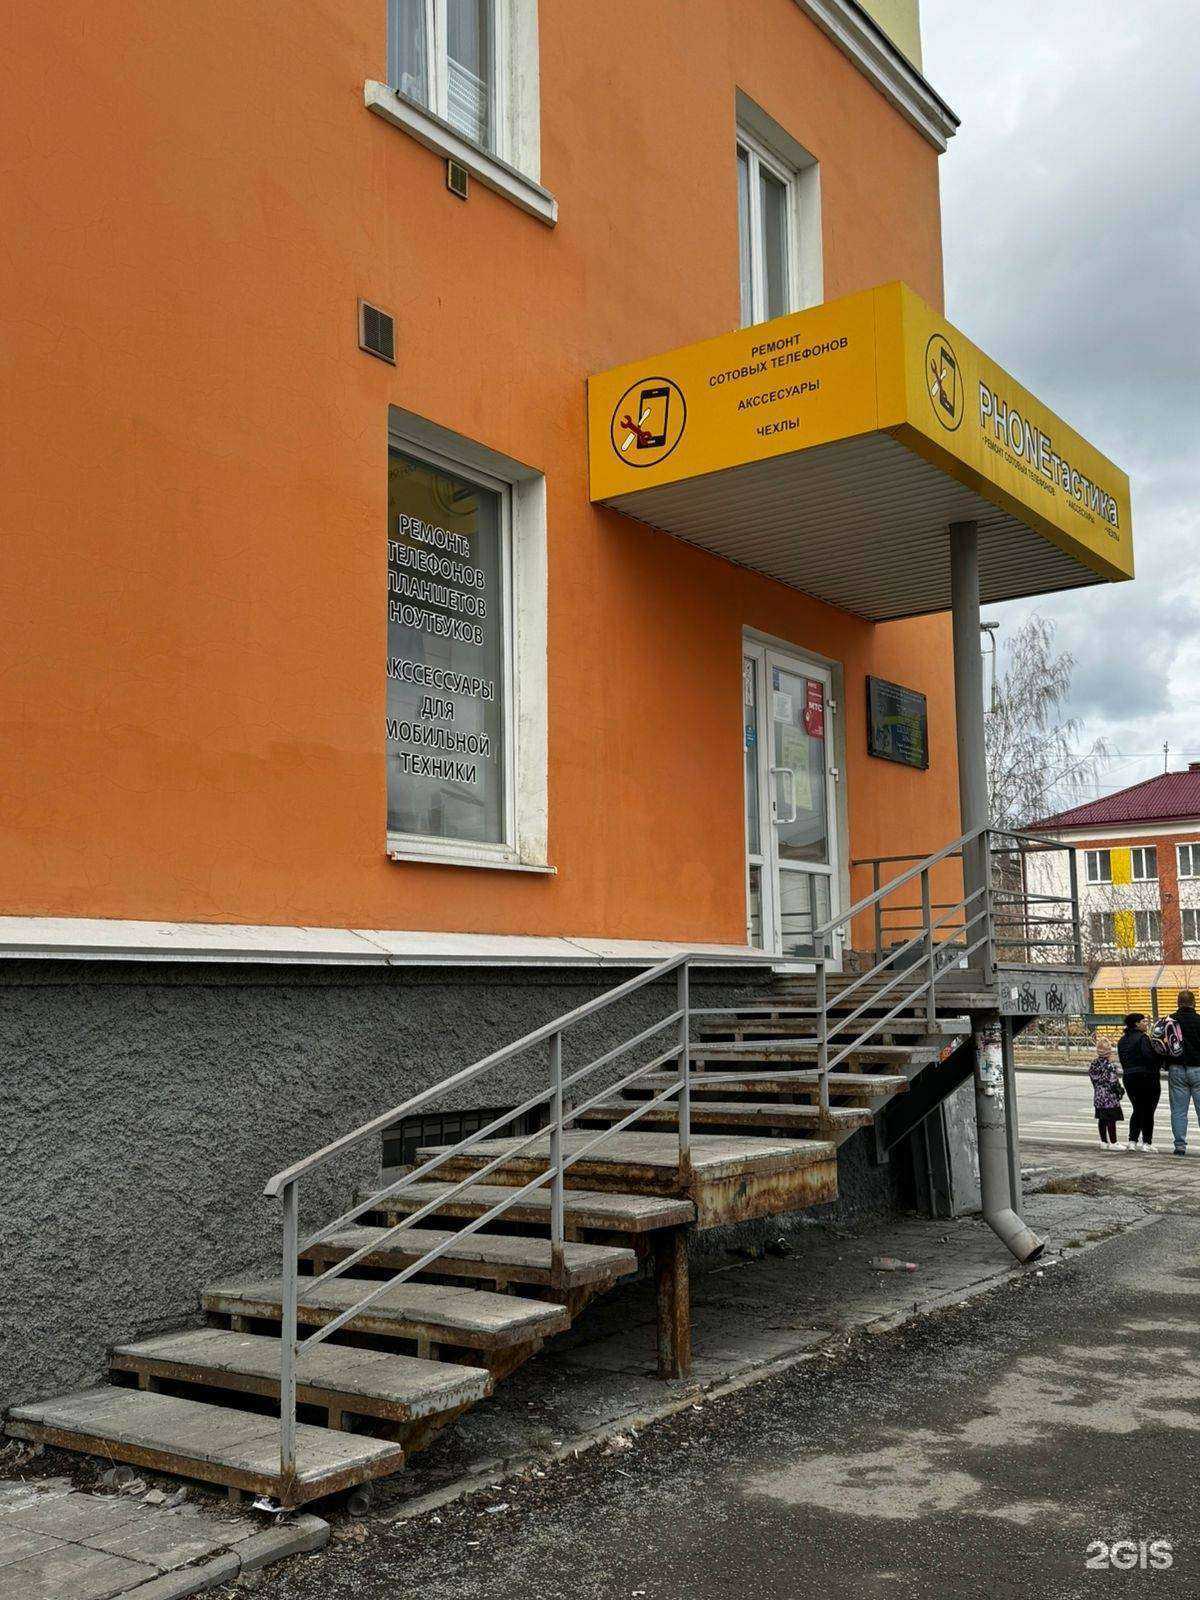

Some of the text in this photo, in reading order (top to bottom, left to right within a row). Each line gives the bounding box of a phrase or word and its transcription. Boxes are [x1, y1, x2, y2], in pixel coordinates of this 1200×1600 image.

[708, 337, 848, 387] СОТОВЫХ ТЕЛЕФОНОВ
[751, 334, 801, 358] РЕМОНТ
[737, 379, 820, 411] АКССЕСУАРЫ
[756, 416, 800, 437] ЧЕХЛЫ
[399, 513, 470, 558] РЕМОНТ:
[387, 540, 485, 589] ТЕЛЕФОНОВ
[387, 570, 487, 618] ПЛАНШЕТОВ
[389, 600, 484, 645] НОУТБУКОВ
[421, 695, 455, 722] ДЛЯ
[808, 701, 823, 712] МТС
[385, 717, 491, 757] МОБИЛЬНОЙ
[400, 751, 477, 784] ТЕХНИКИ
